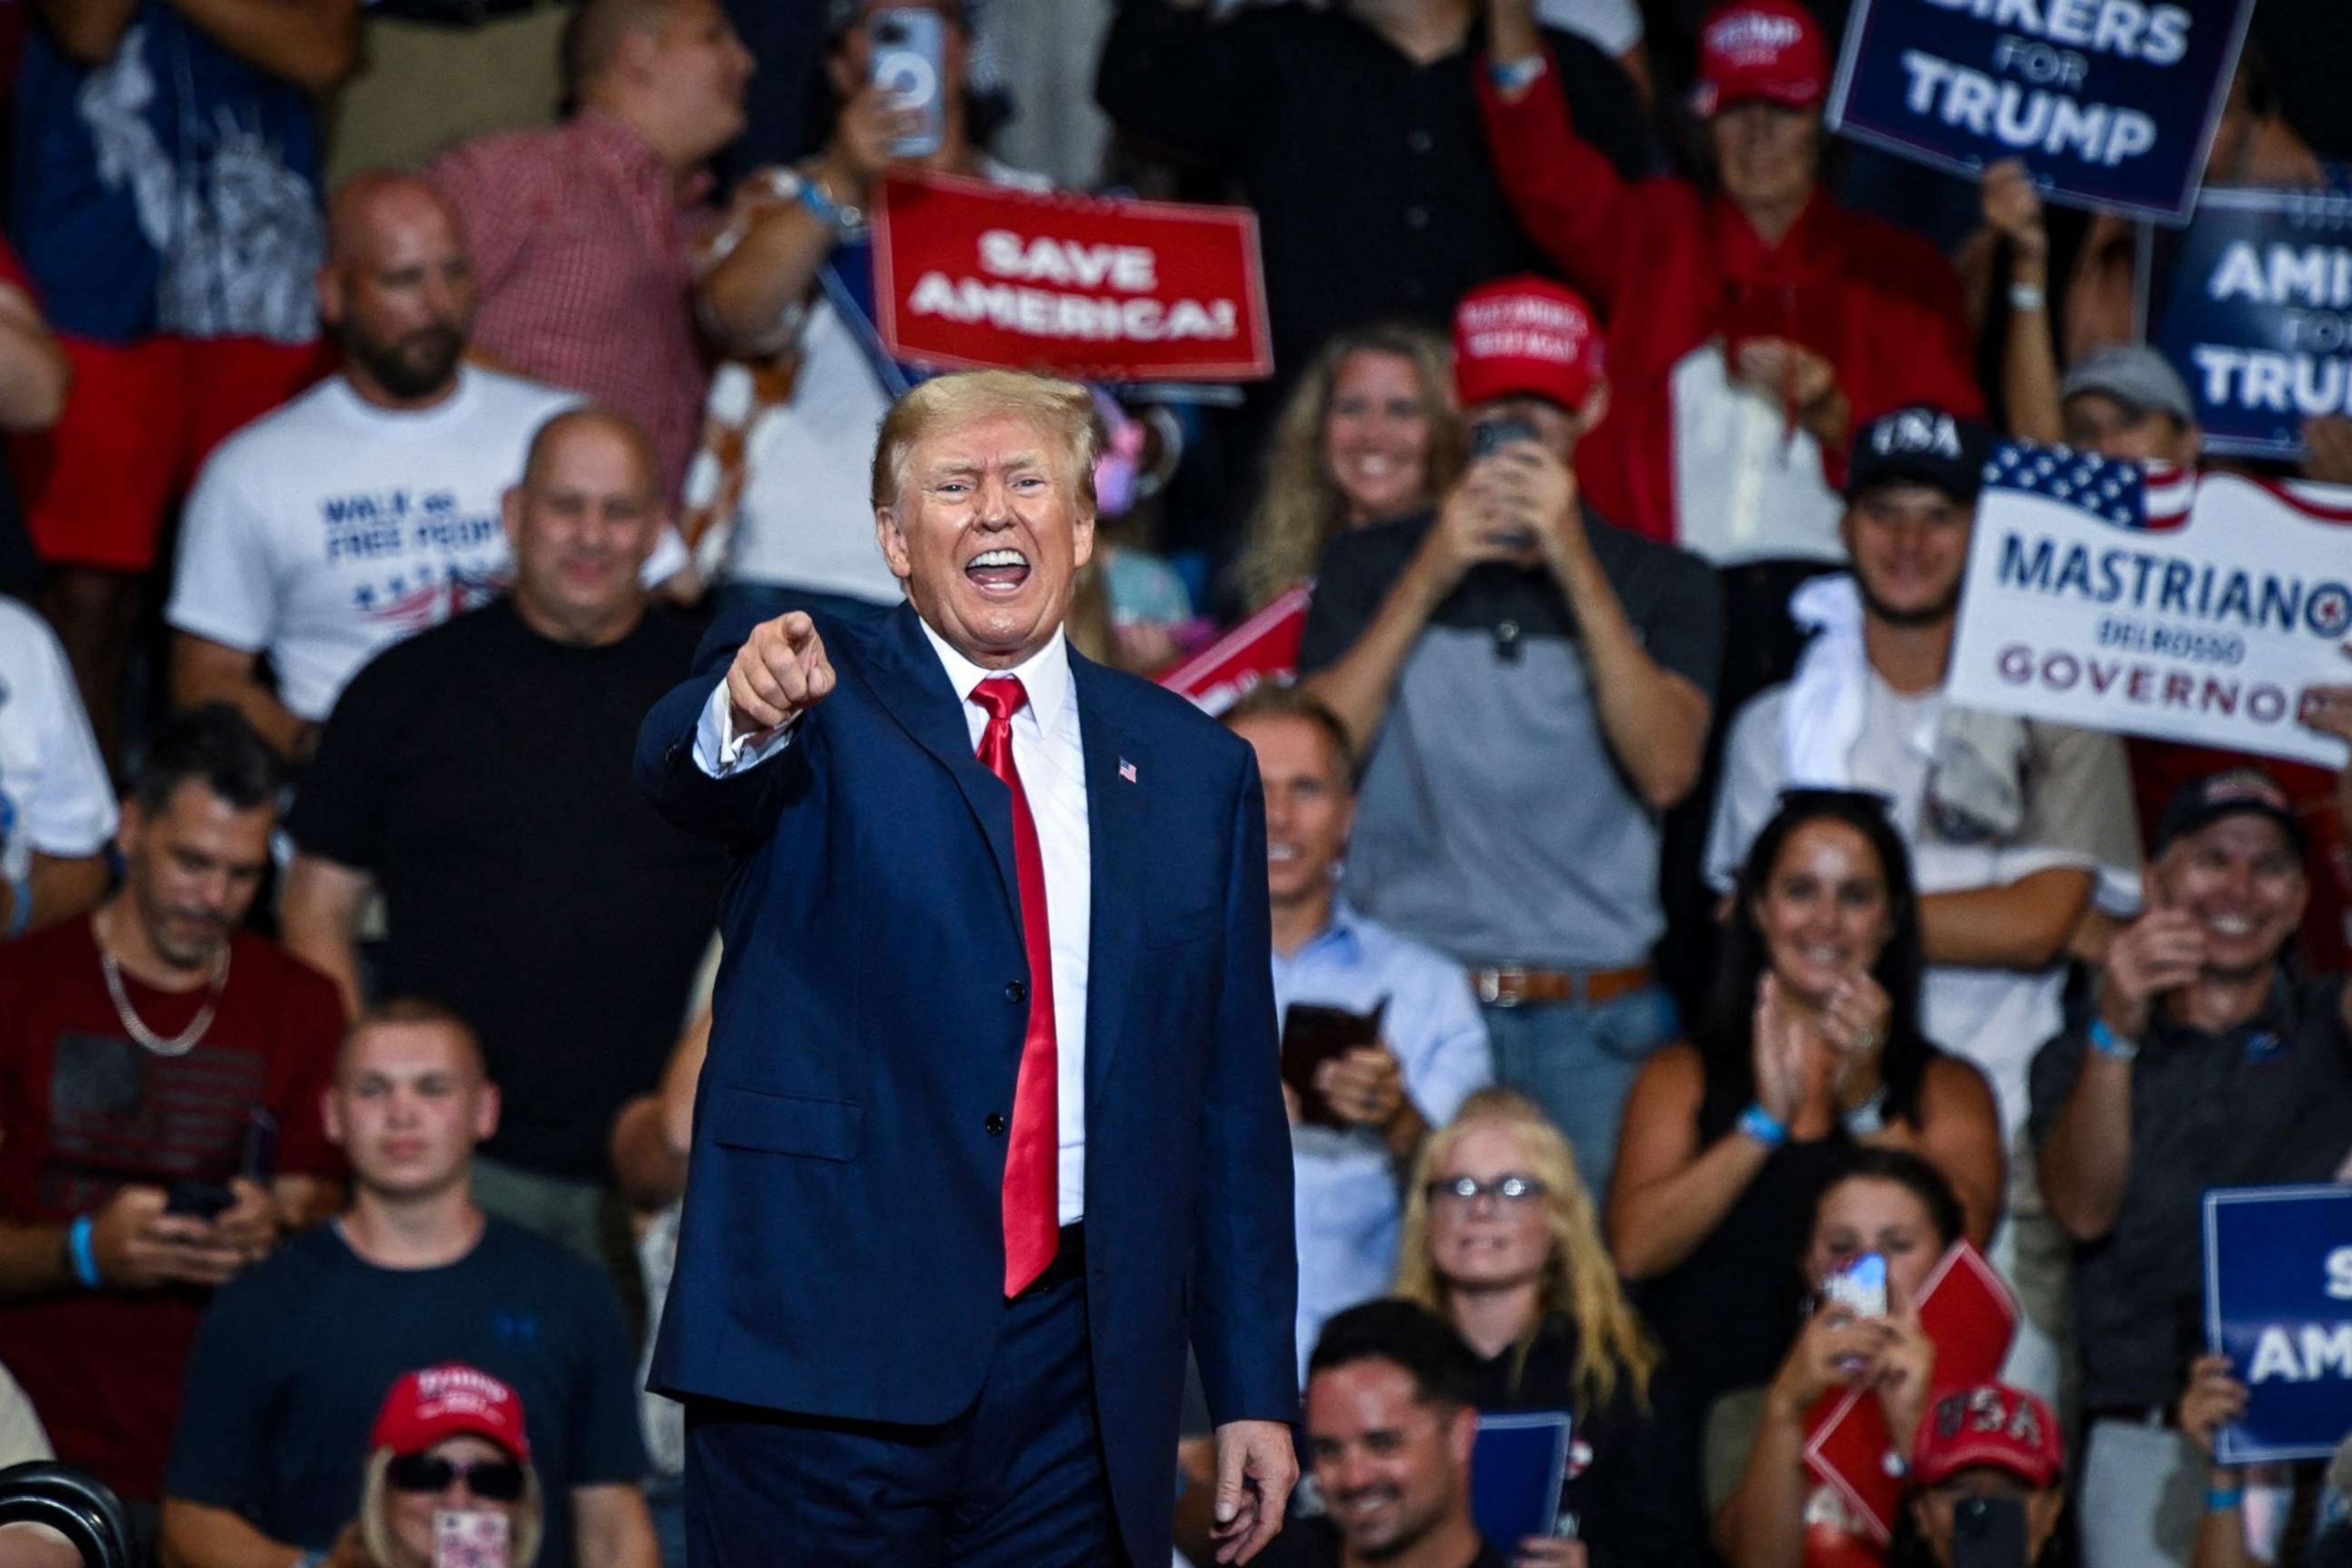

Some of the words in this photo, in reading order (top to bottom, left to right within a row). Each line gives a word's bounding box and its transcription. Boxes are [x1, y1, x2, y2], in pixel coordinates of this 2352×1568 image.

[1923, 0, 2194, 67] KERS
[1995, 34, 2089, 92] FOR
[1901, 48, 2158, 167] TRUMP
[978, 230, 1158, 292] SAVE
[909, 270, 1239, 342] AMERICA!
[2193, 343, 2352, 416] TRU
[1873, 407, 1963, 459] USA
[325, 492, 405, 522] WALK
[325, 524, 401, 562] FREE
[1998, 534, 2352, 638] MASTRIANO
[1938, 1387, 2043, 1447] USA
